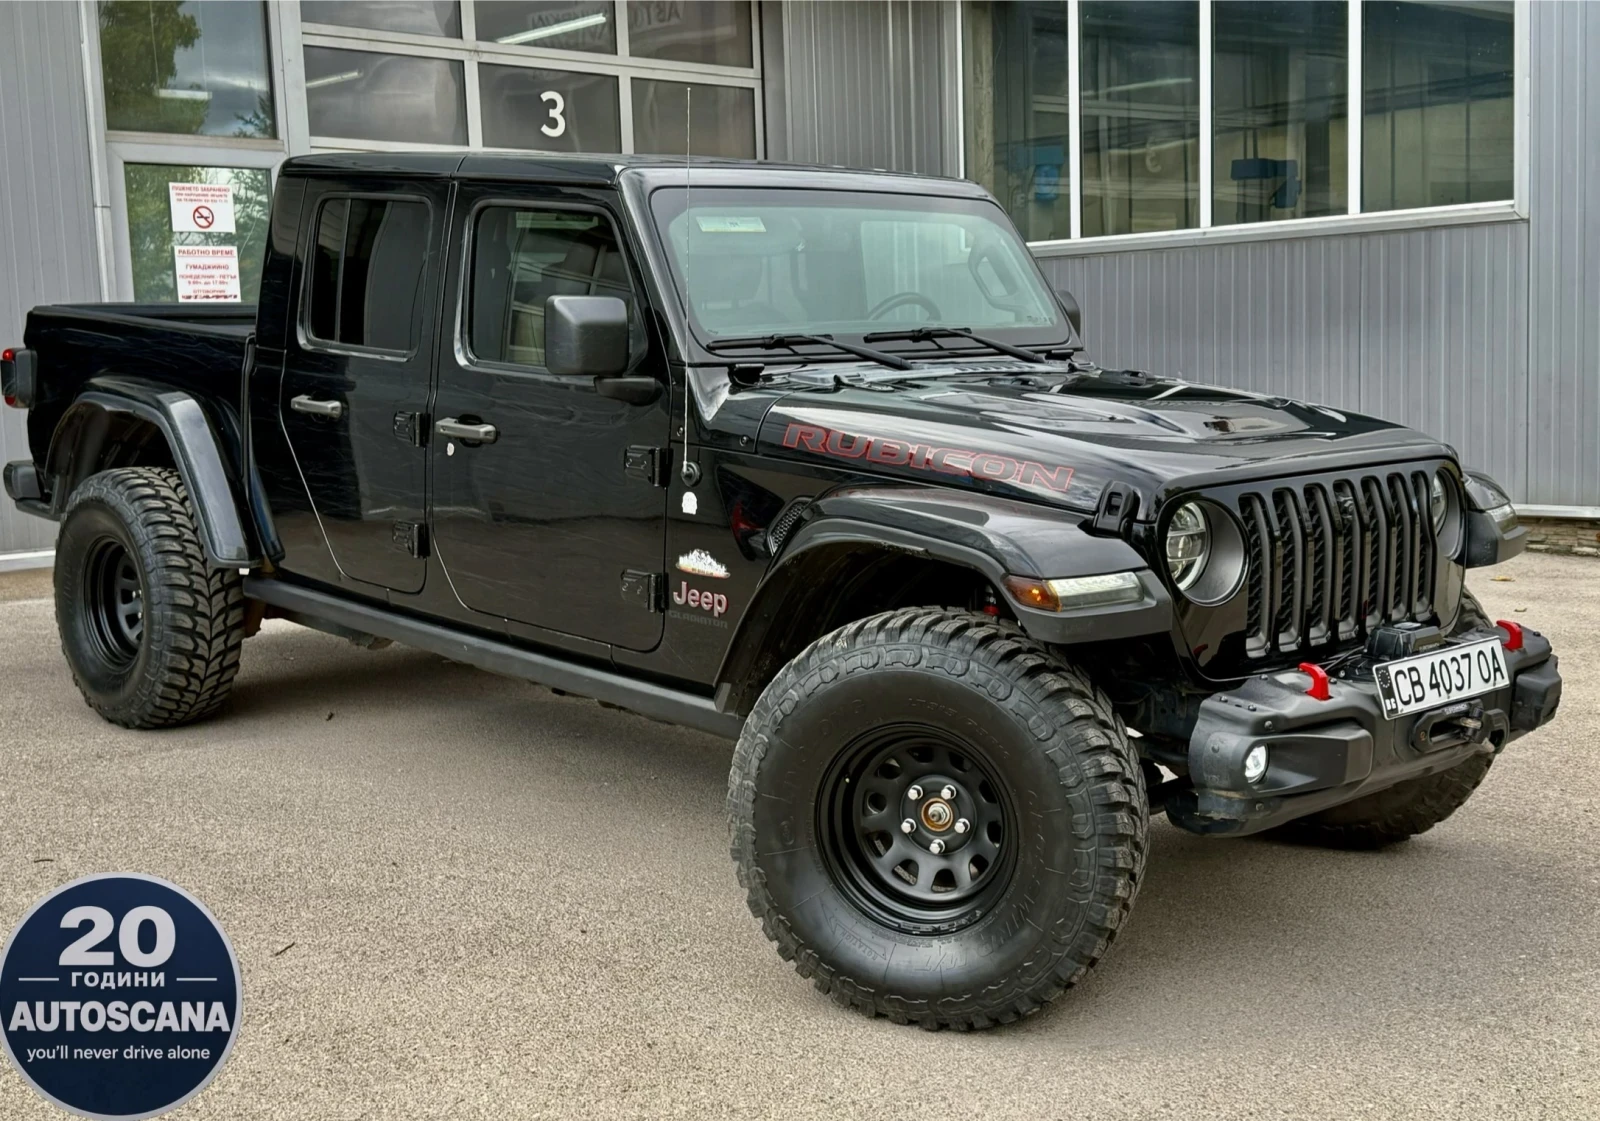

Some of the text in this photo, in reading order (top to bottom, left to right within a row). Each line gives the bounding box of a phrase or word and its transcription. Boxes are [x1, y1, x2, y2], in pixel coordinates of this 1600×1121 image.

[540, 90, 566, 138] 3
[782, 422, 1075, 493] RUBICON
[673, 581, 729, 618] Jeep
[1394, 646, 1505, 706] CB 4037 OA
